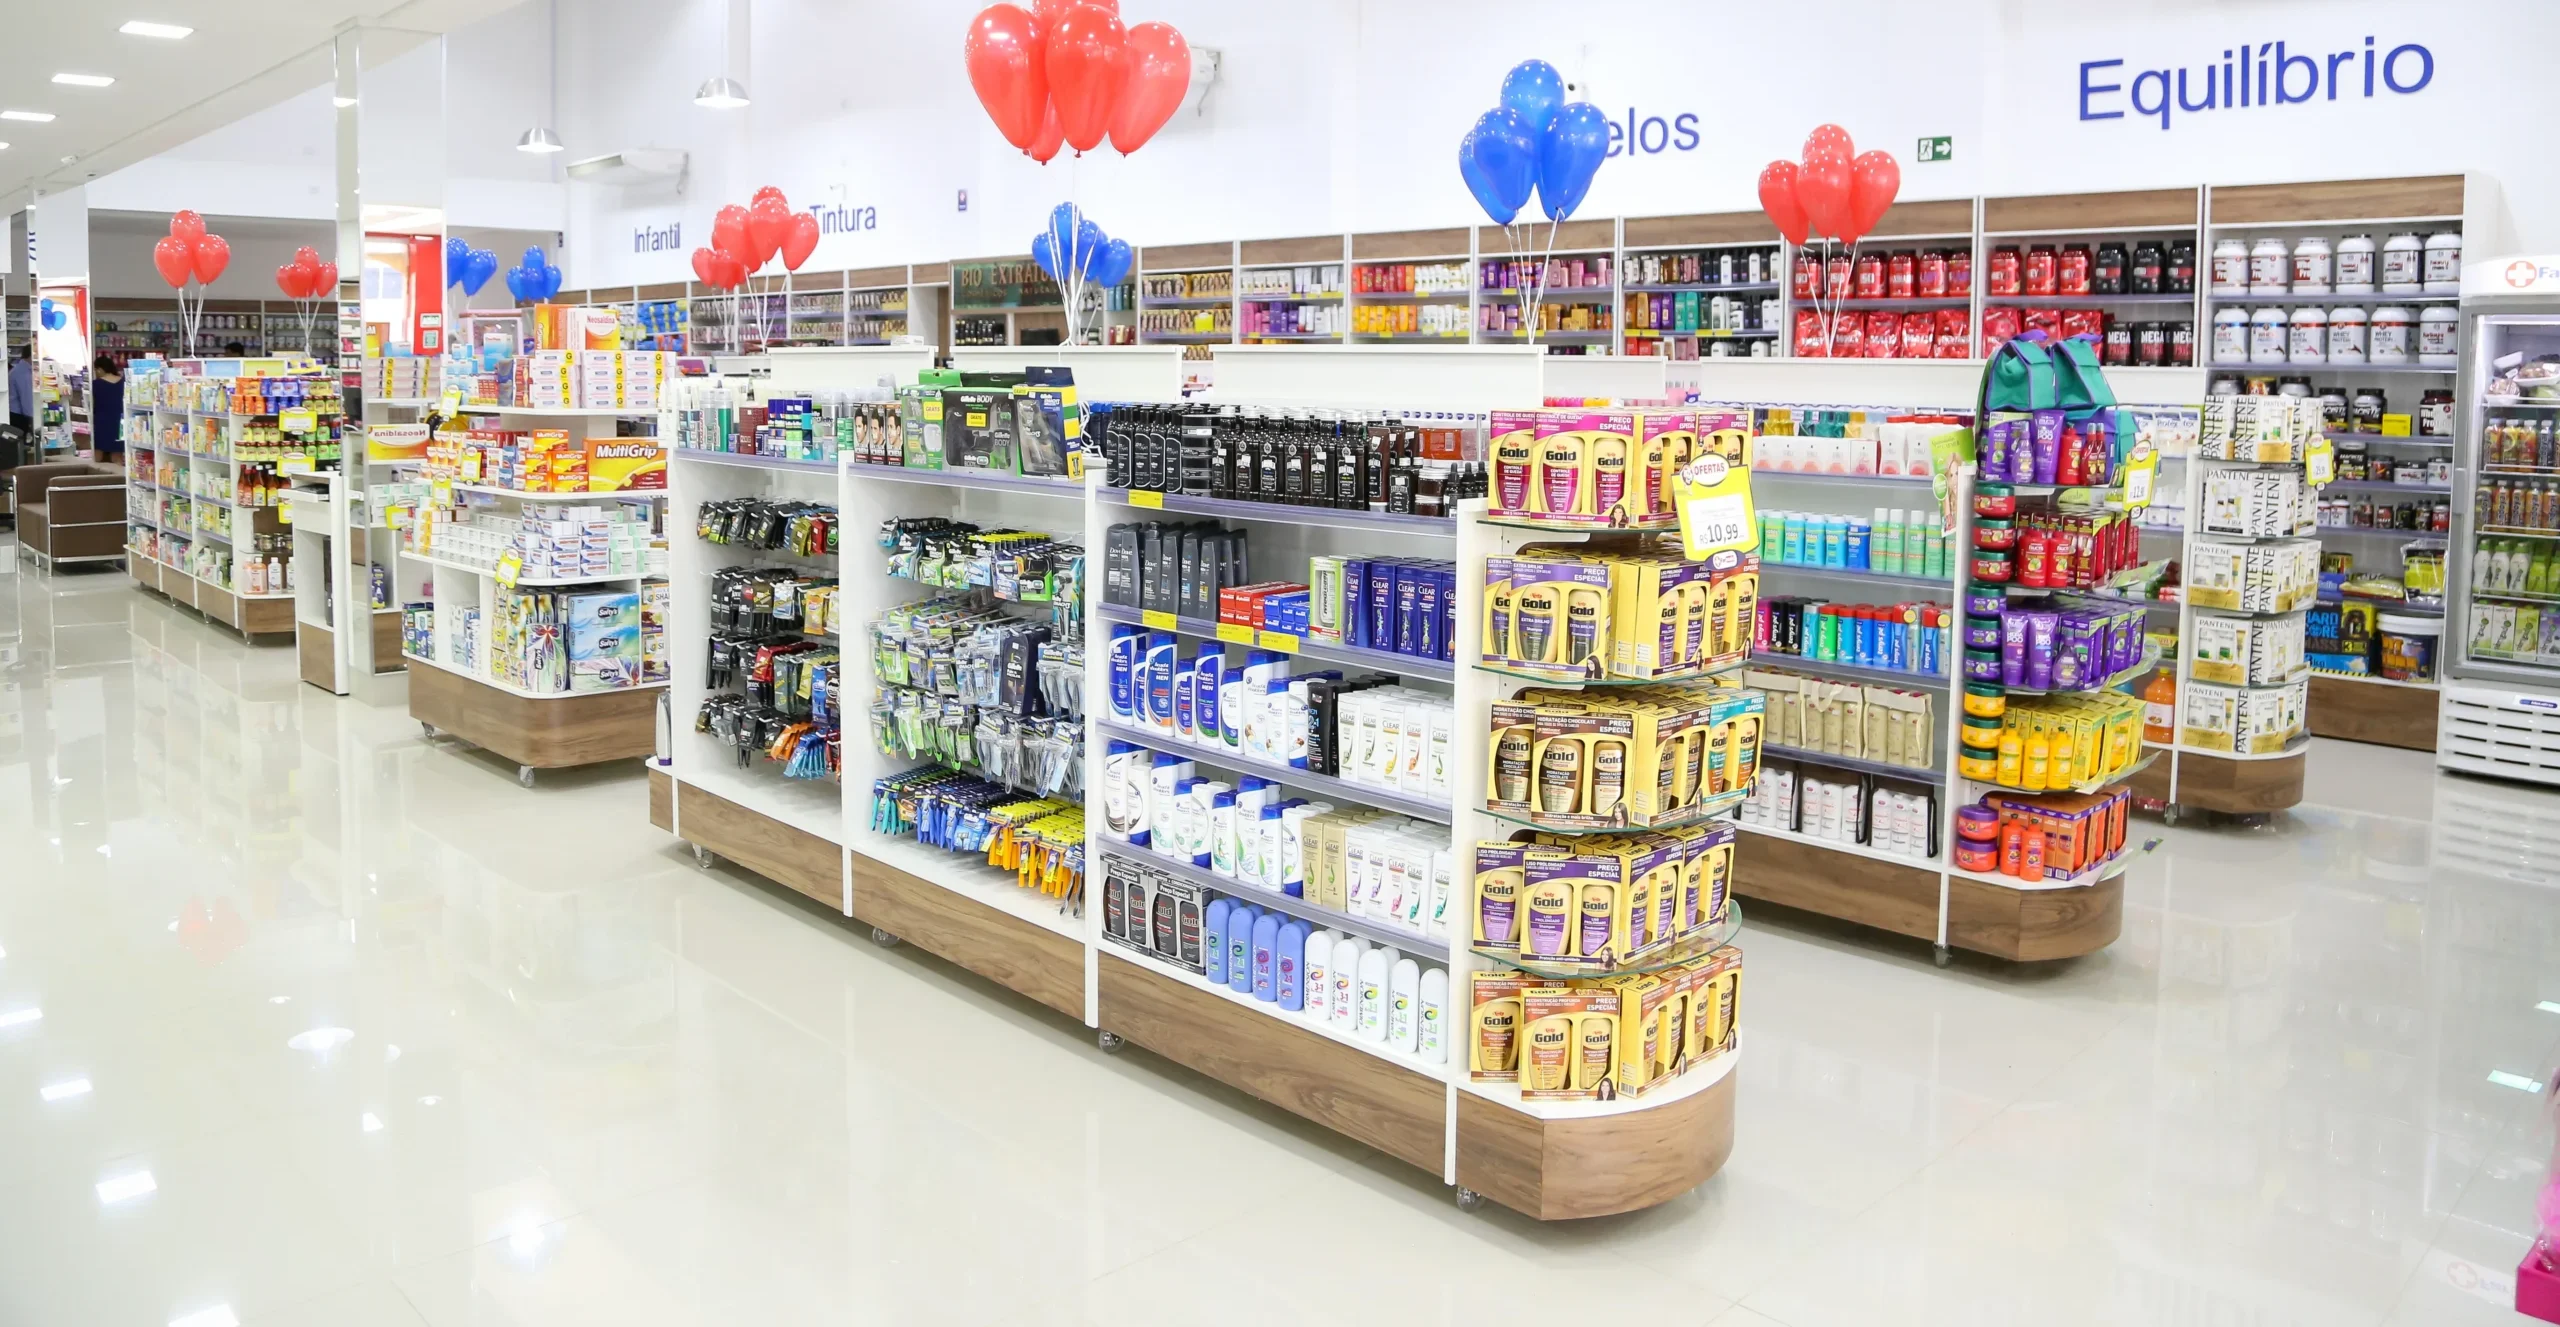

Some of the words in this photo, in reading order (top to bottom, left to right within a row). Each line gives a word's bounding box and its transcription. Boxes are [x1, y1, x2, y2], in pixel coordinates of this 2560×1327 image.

[2080, 35, 2434, 130] Equilíbrio
[809, 205, 876, 234] Tintura
[634, 222, 680, 253] Infantil
[962, 268, 982, 287] BIO
[991, 264, 1049, 284] EXTRATU
[587, 315, 615, 324] Neosaldina
[2108, 332, 2130, 344] MEGA
[2141, 332, 2164, 344] MEGA
[566, 352, 573, 360] G
[615, 353, 622, 361] G
[655, 353, 662, 361] G
[656, 368, 662, 376] G
[563, 397, 570, 405] G
[617, 397, 623, 405] G
[976, 395, 993, 403] BODY
[1609, 417, 1631, 425] PREÇO
[1600, 423, 1631, 431] ESPECIAL
[2203, 396, 2215, 457] PANTENE
[2212, 396, 2224, 458] PANTENE
[2235, 397, 2247, 460] PANTENE
[2245, 398, 2257, 461] PANTENE
[597, 444, 657, 458] MultiGrip
[1500, 447, 1529, 458] Gold
[1546, 451, 1576, 461] Gold
[1598, 457, 1623, 466] Gold
[1694, 463, 1725, 475] OFERTAS
[2252, 473, 2264, 536] PANTENE
[2265, 474, 2280, 537] PANTENE
[1707, 523, 1738, 544] 10,99
[2195, 545, 2231, 555] PANTENE
[1372, 580, 1388, 589] CLEAR
[2244, 548, 2259, 611] PANTENE
[2260, 549, 2274, 612] PANTENE
[1398, 584, 1415, 593] CLEAR
[1419, 586, 1435, 595] CLEAR
[1522, 598, 1551, 609] Gold
[1570, 606, 1594, 615] Gold
[2199, 619, 2235, 629] PANTENE
[2251, 621, 2263, 684] PANTENE
[2189, 687, 2224, 697] PANTENE
[1382, 720, 1400, 729] CLEAR
[2236, 691, 2249, 754] PANTENE
[1500, 741, 1529, 751] Gold
[1545, 751, 1574, 761] Gold
[1599, 756, 1622, 764] Gold
[1389, 859, 1405, 868] CLEAR
[1407, 865, 1422, 876] CLEAR
[1484, 884, 1513, 895] Gold
[1534, 897, 1563, 907] Gold
[1583, 901, 1608, 910] Gold
[1484, 1016, 1513, 1026] Gold
[1535, 1033, 1563, 1043] Gold
[1586, 1034, 1610, 1043] Gold
